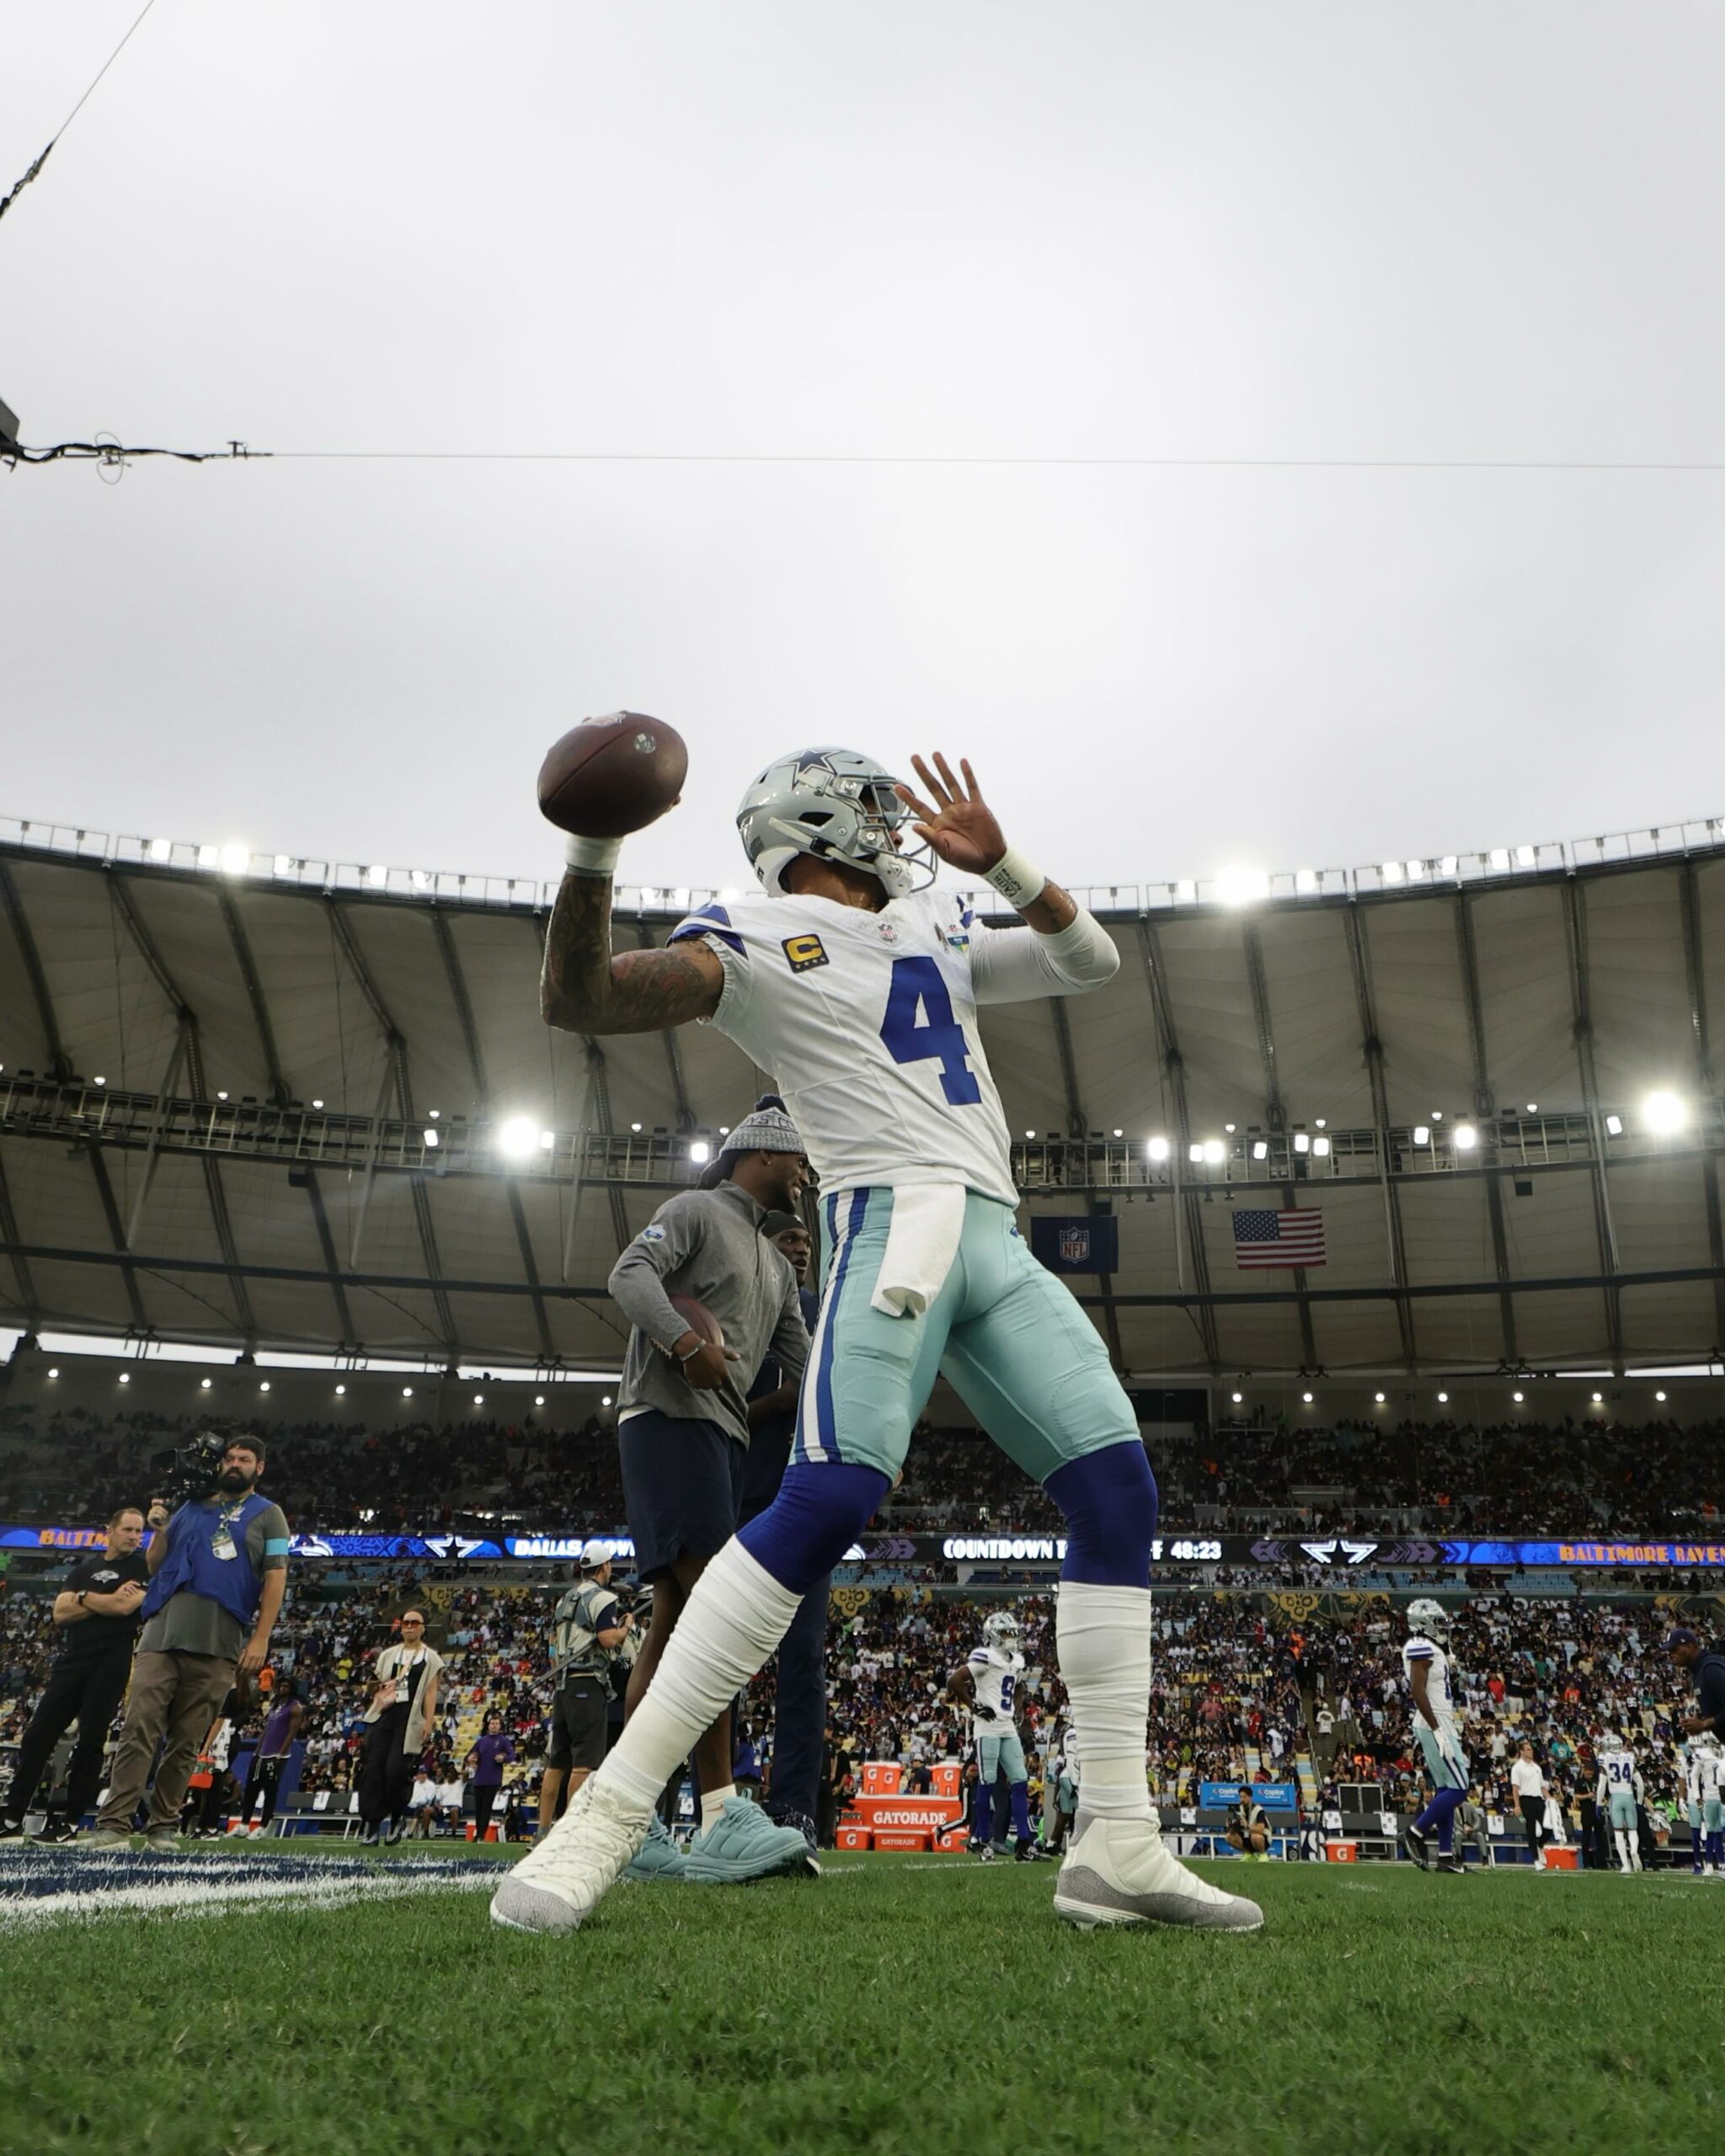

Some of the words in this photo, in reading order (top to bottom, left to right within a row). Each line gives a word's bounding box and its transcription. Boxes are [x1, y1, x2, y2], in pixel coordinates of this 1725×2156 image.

[787, 936, 823, 963] C
[879, 955, 983, 1106] 4
[1064, 1242, 1087, 1258] NFL
[39, 1529, 142, 1547] BALTIME
[514, 1540, 583, 1556] DALLAS
[943, 1540, 1053, 1559] COUNTDOWN
[1170, 1541, 1222, 1560] 48:23
[1560, 1545, 1669, 1562] BALTIMORE
[1000, 1675, 1016, 1711] 9
[868, 1769, 878, 1780] G
[884, 1772, 894, 1785] G
[943, 1769, 954, 1782] G
[1609, 1763, 1632, 1784] 34
[873, 1811, 948, 1825] GATORADE
[846, 1833, 857, 1846] G
[941, 1835, 952, 1848] G
[1336, 1847, 1348, 1861] G
